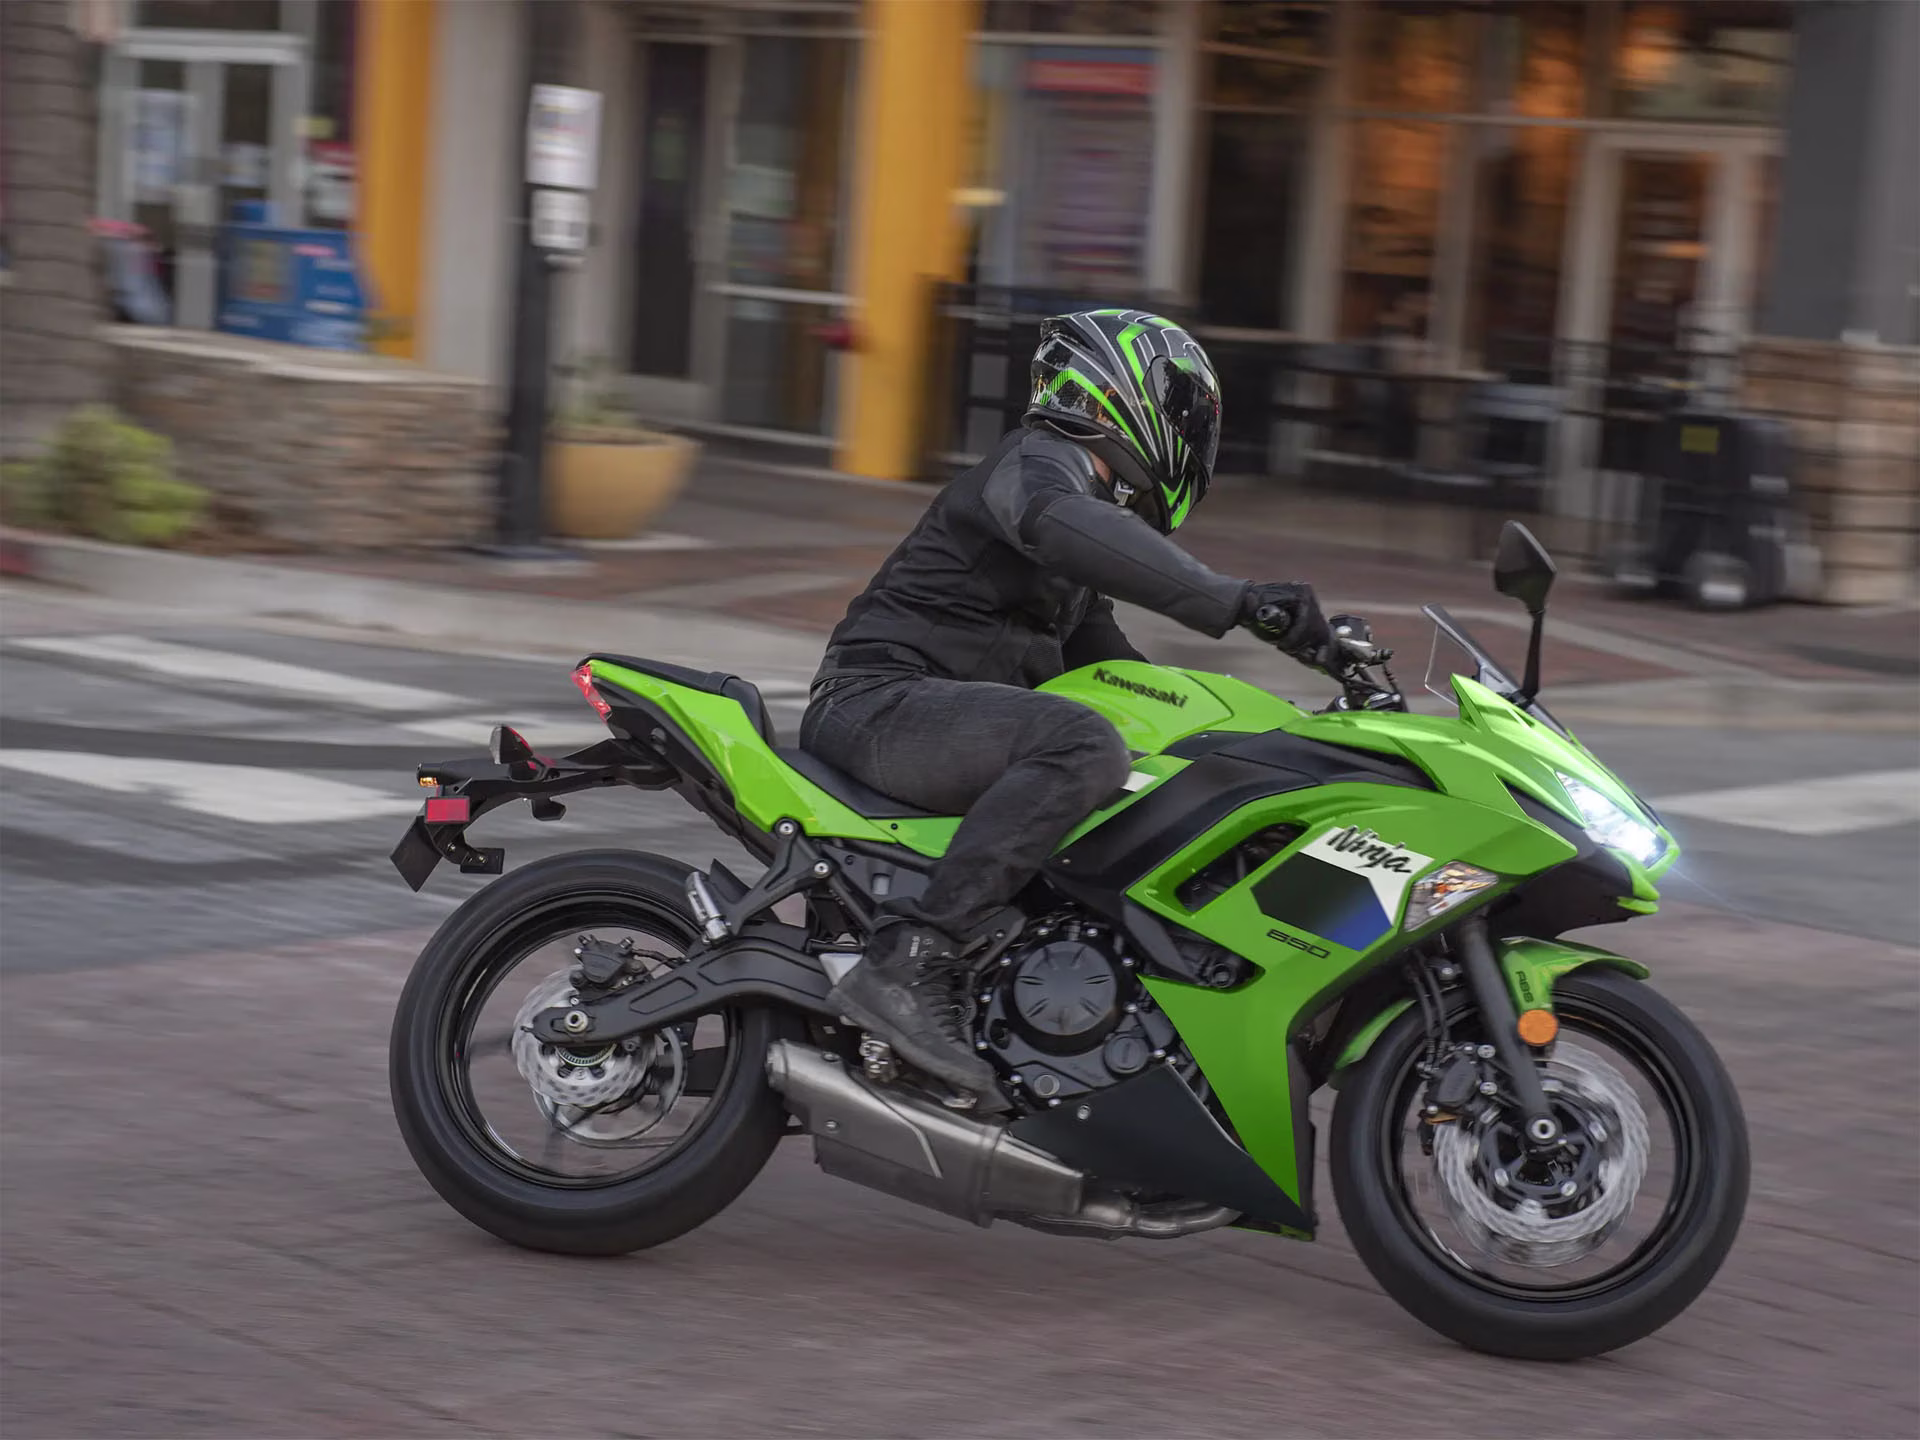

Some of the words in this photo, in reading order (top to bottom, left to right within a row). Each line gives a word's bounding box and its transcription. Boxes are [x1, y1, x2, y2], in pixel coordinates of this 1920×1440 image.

[1093, 667, 1189, 708] Kawasaki
[1327, 825, 1413, 873] Ninja
[1266, 928, 1331, 959] 650
[1516, 971, 1534, 1003] ABS
